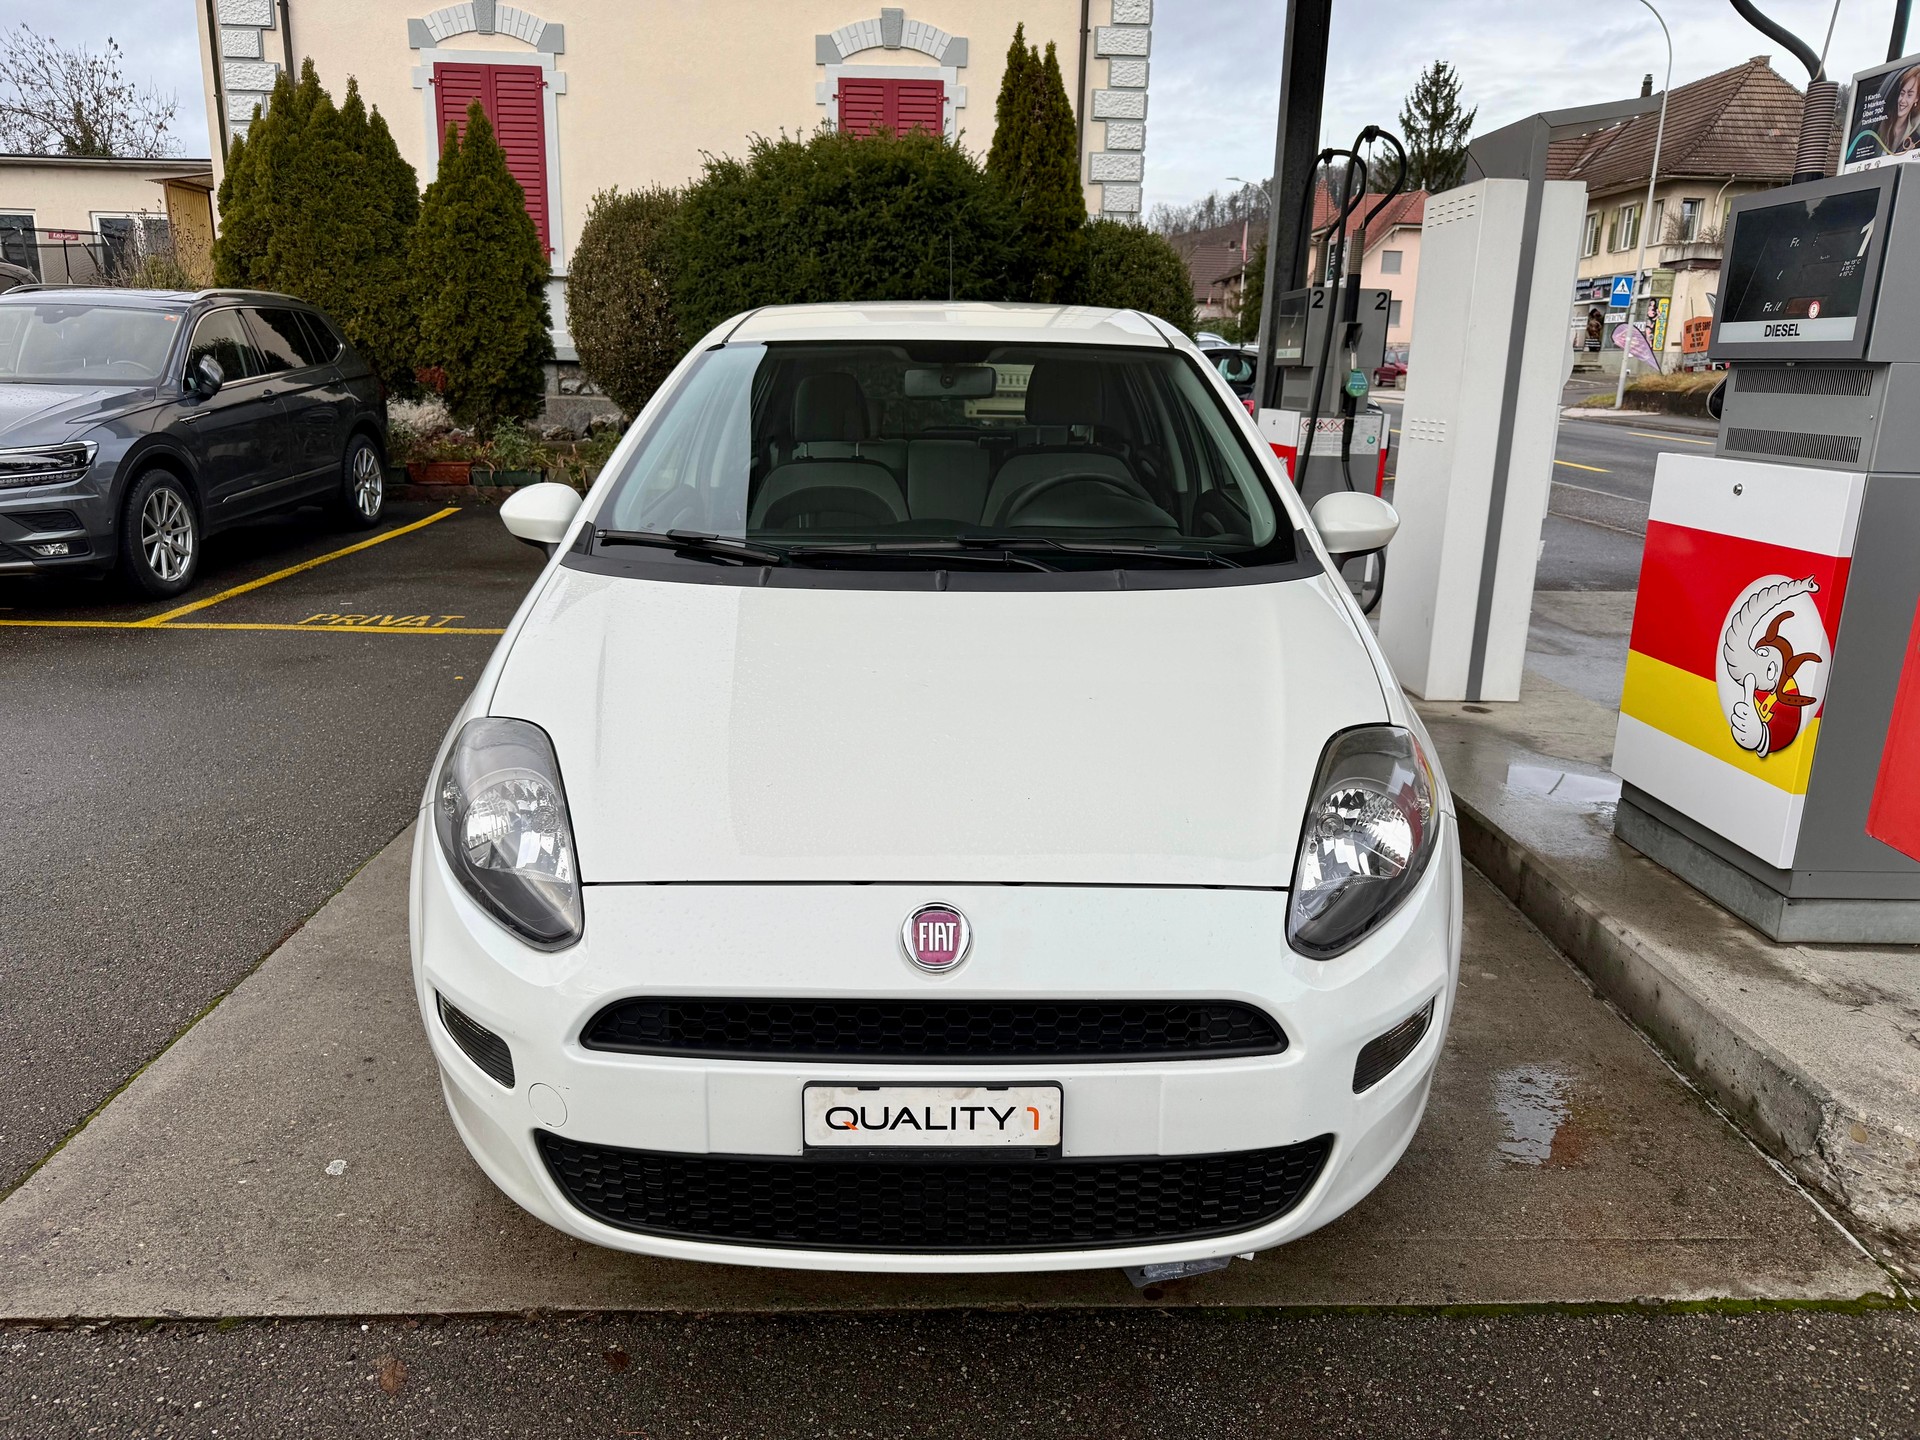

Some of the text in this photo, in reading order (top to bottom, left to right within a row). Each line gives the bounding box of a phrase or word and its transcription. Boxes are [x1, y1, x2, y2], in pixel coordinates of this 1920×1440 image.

[1790, 237, 1800, 248] Fr.
[1857, 215, 1876, 257] 1
[1312, 290, 1324, 309] 2
[1374, 291, 1388, 310] 2
[1655, 303, 1669, 350] TATTOO
[1764, 323, 1800, 337] DIESEL
[297, 613, 466, 628] PRIVAT
[918, 922, 957, 952] FIAT
[825, 1106, 1040, 1131] QUALITY 1
